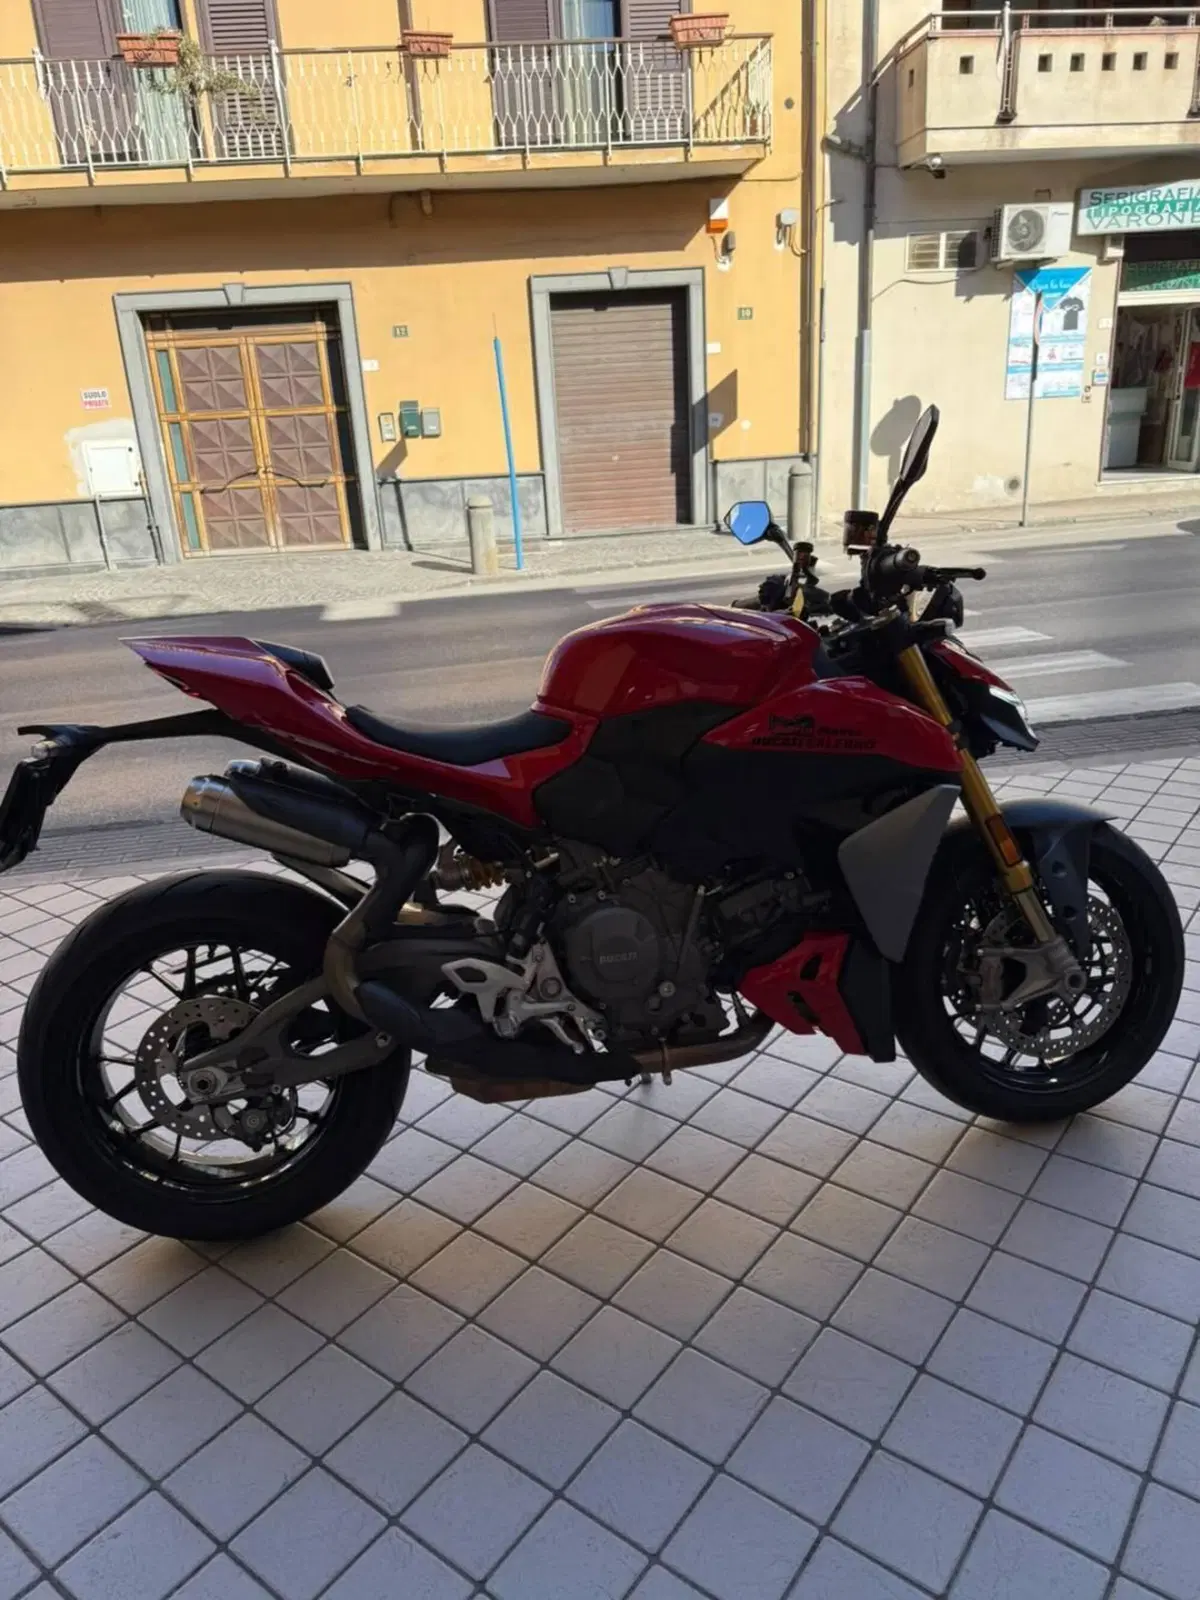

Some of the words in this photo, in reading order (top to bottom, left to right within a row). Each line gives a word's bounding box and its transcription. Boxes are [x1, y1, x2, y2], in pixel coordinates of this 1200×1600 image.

[1088, 212, 1200, 229] VARONE
[83, 391, 107, 399] SUOLO
[599, 951, 638, 965] DUCATI
